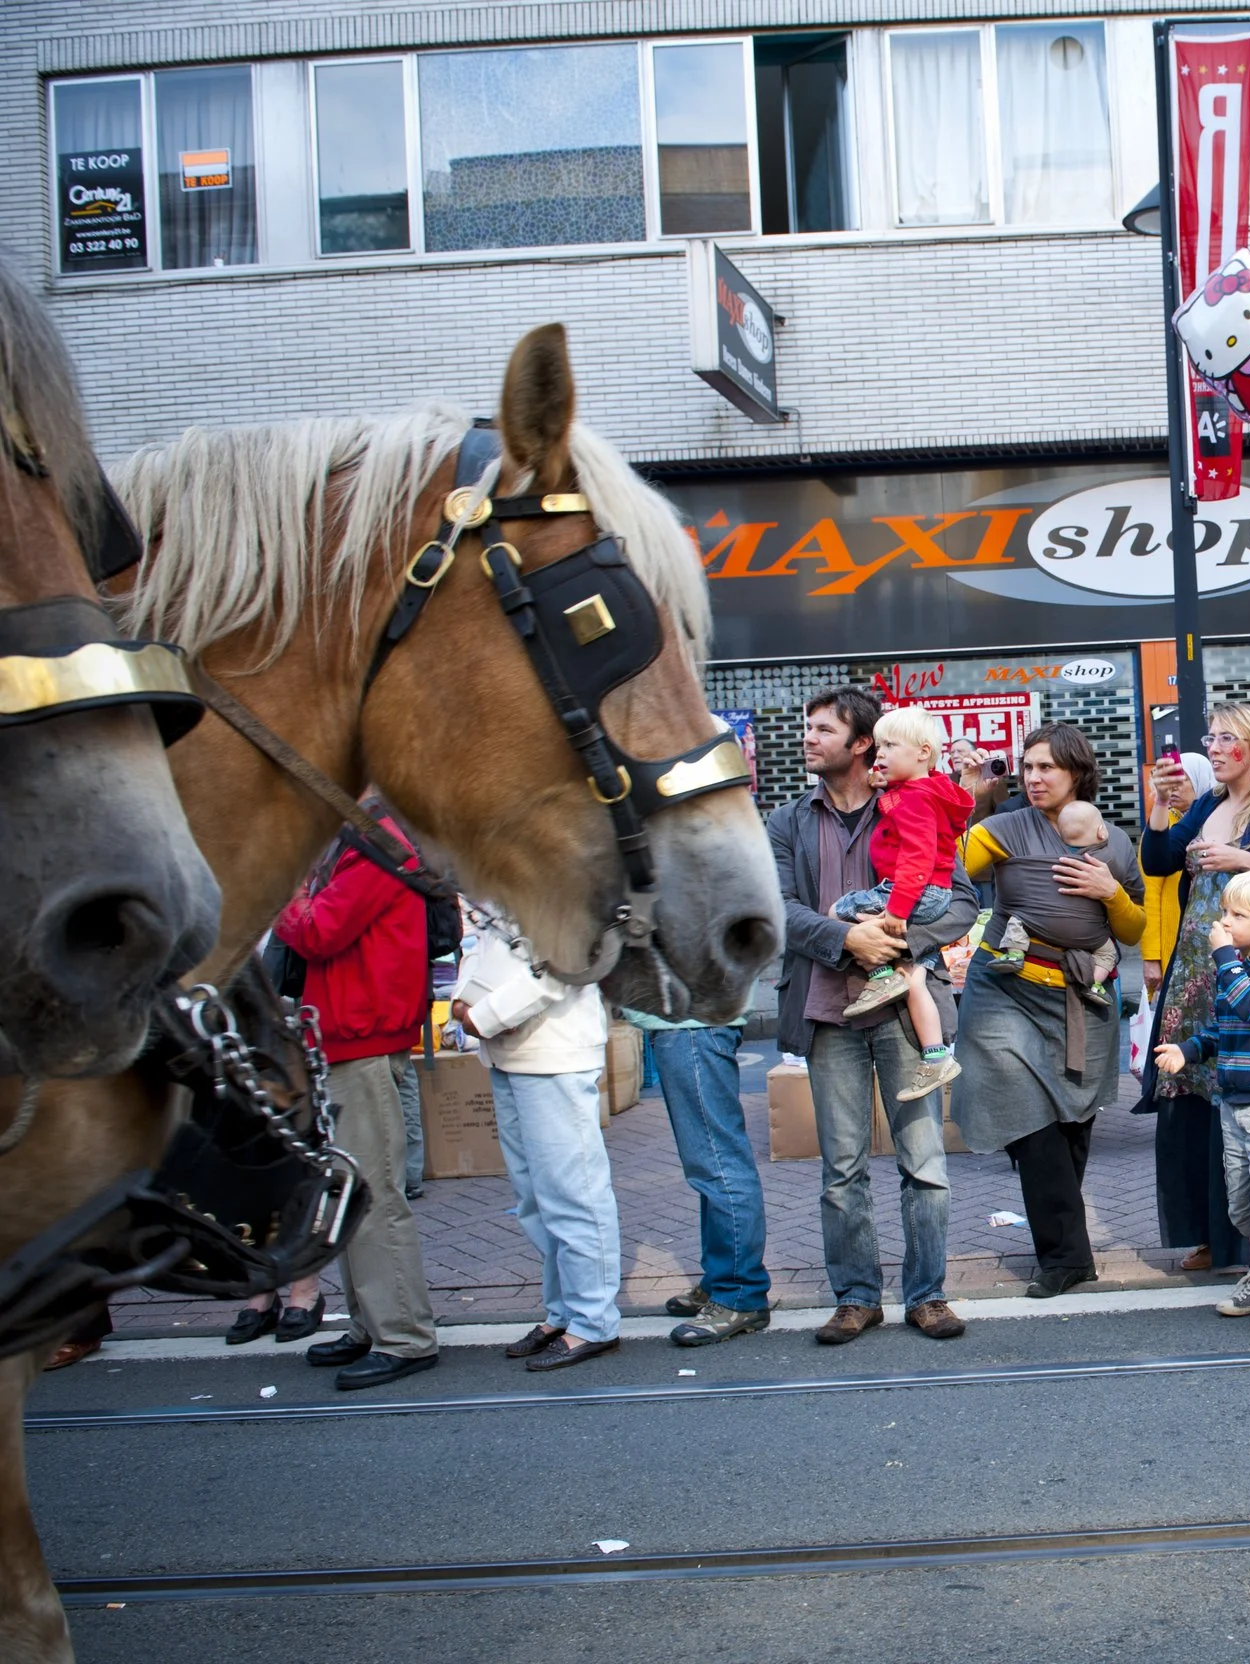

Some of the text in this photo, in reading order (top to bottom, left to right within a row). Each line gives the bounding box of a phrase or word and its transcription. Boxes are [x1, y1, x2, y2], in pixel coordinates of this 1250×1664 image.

[69, 153, 130, 171] TE KOOP
[184, 174, 228, 188] TE KOOP
[69, 237, 139, 253] 03 322 40 90
[744, 311, 769, 353] shop
[682, 507, 1034, 597] MAXI
[872, 663, 944, 706] New
[984, 663, 1114, 685] MAXI shop
[909, 699, 960, 709] LAATSTE
[963, 695, 1026, 707] AFPRIJZING
[930, 712, 1007, 743] ALE
